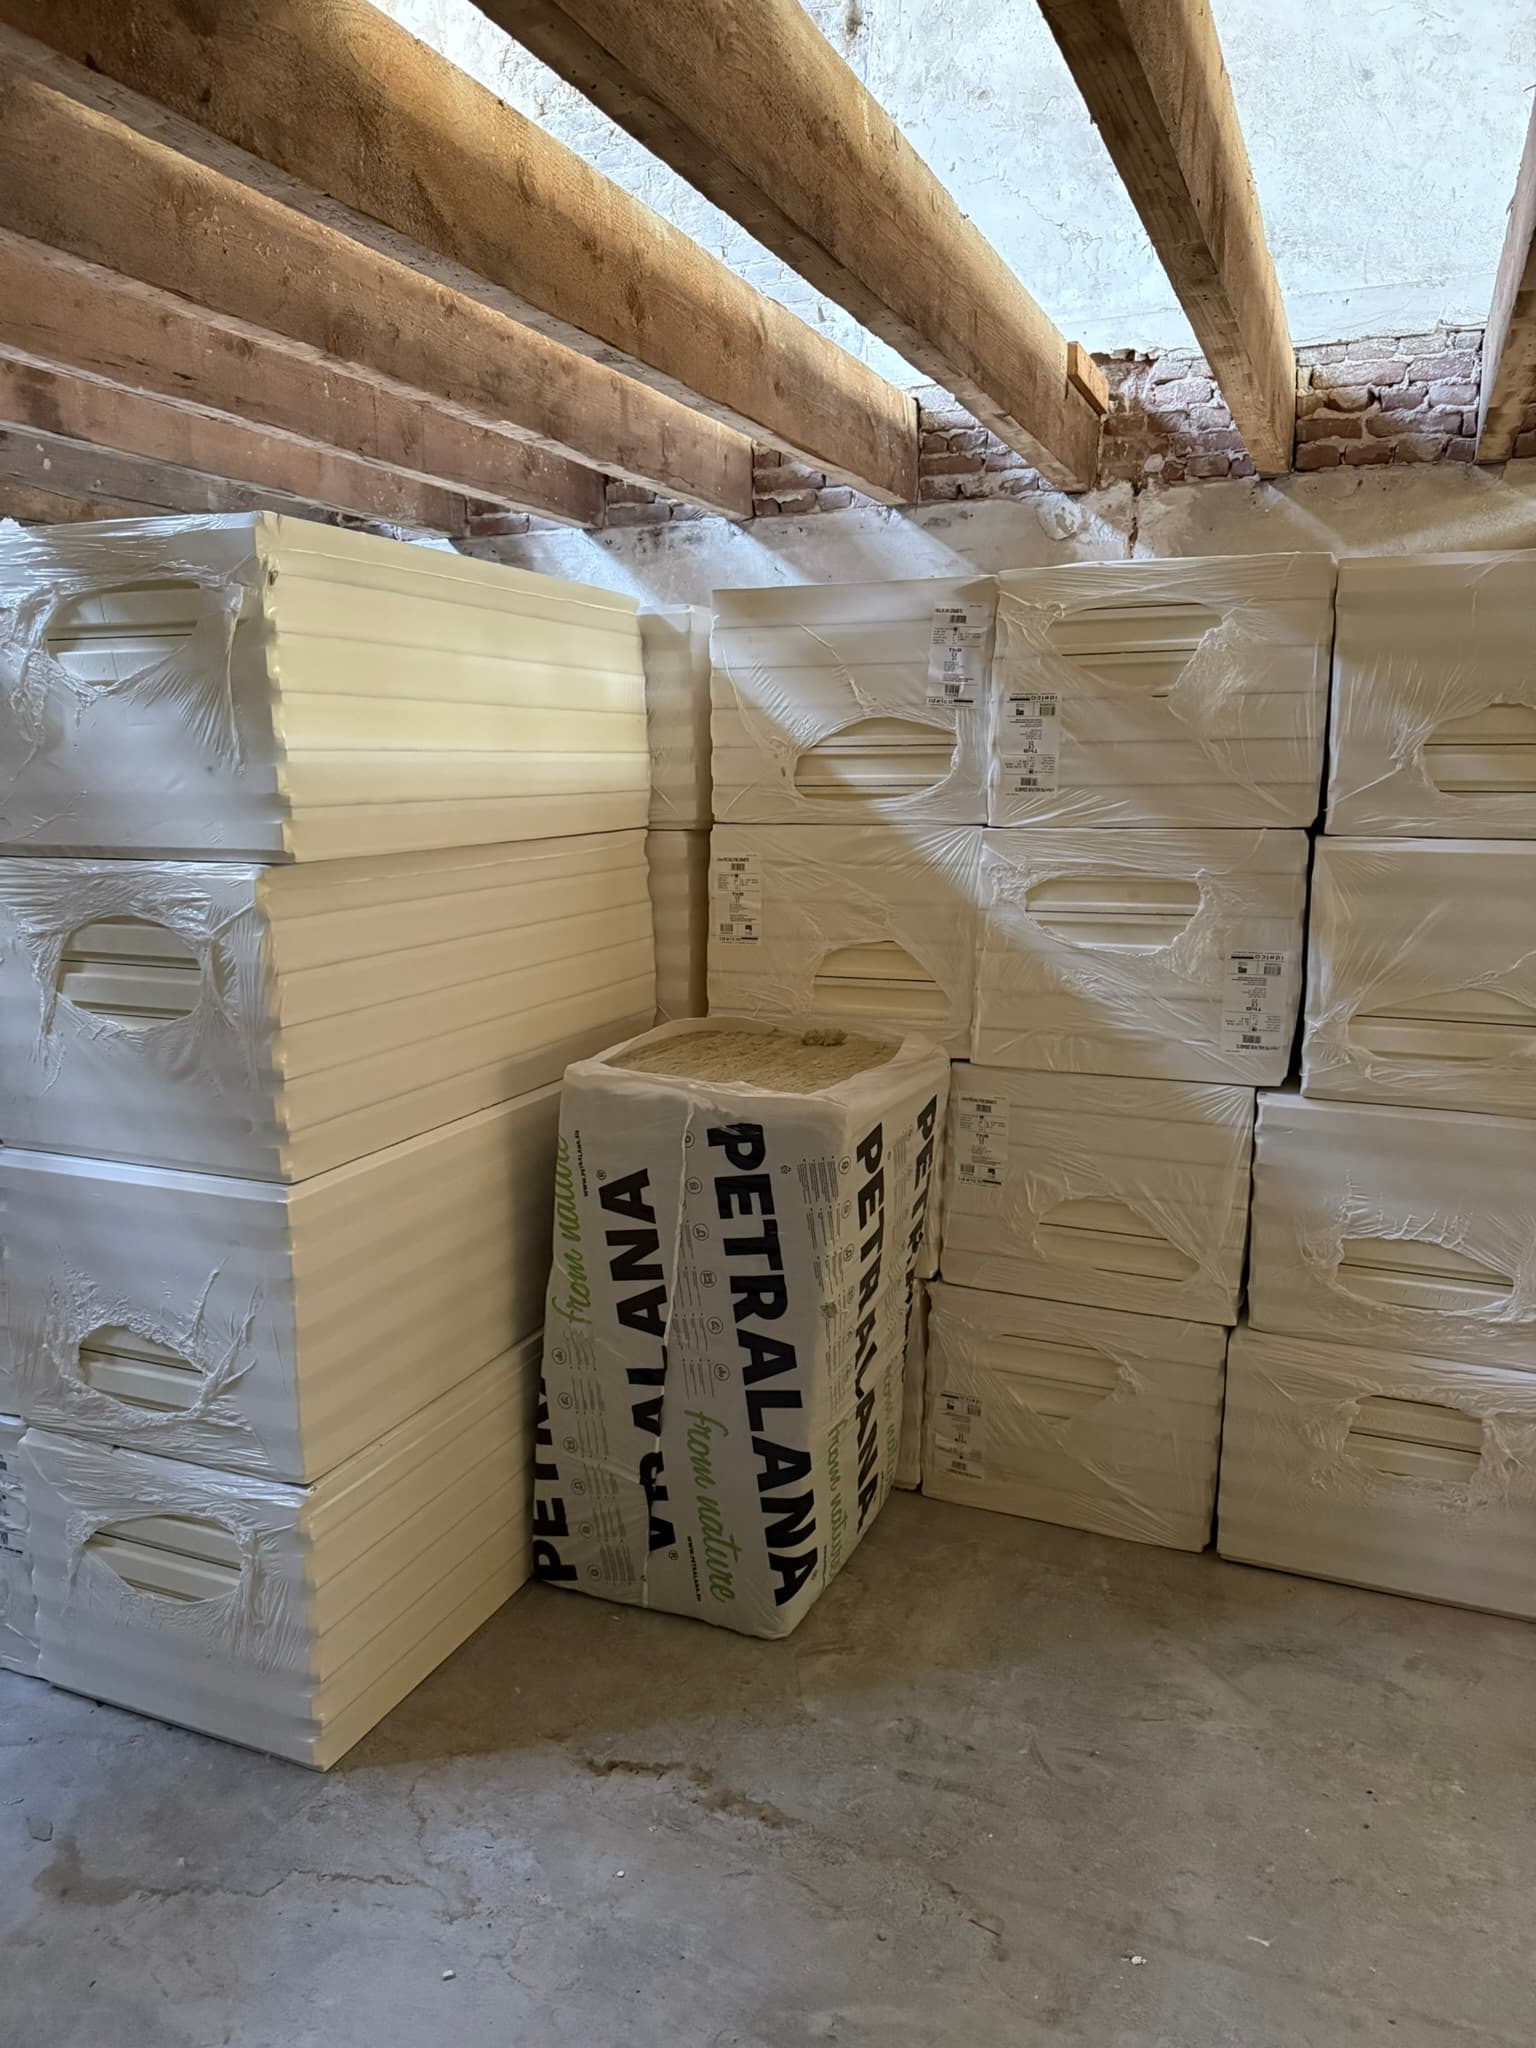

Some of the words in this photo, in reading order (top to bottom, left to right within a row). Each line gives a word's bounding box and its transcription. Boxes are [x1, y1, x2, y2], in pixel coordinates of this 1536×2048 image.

[551, 1248, 593, 1335] from
[855, 1121, 885, 1535] PETRALANA
[706, 1123, 818, 1606] PETRALANA
[684, 1410, 729, 1489] from
[696, 1495, 743, 1603] nature
